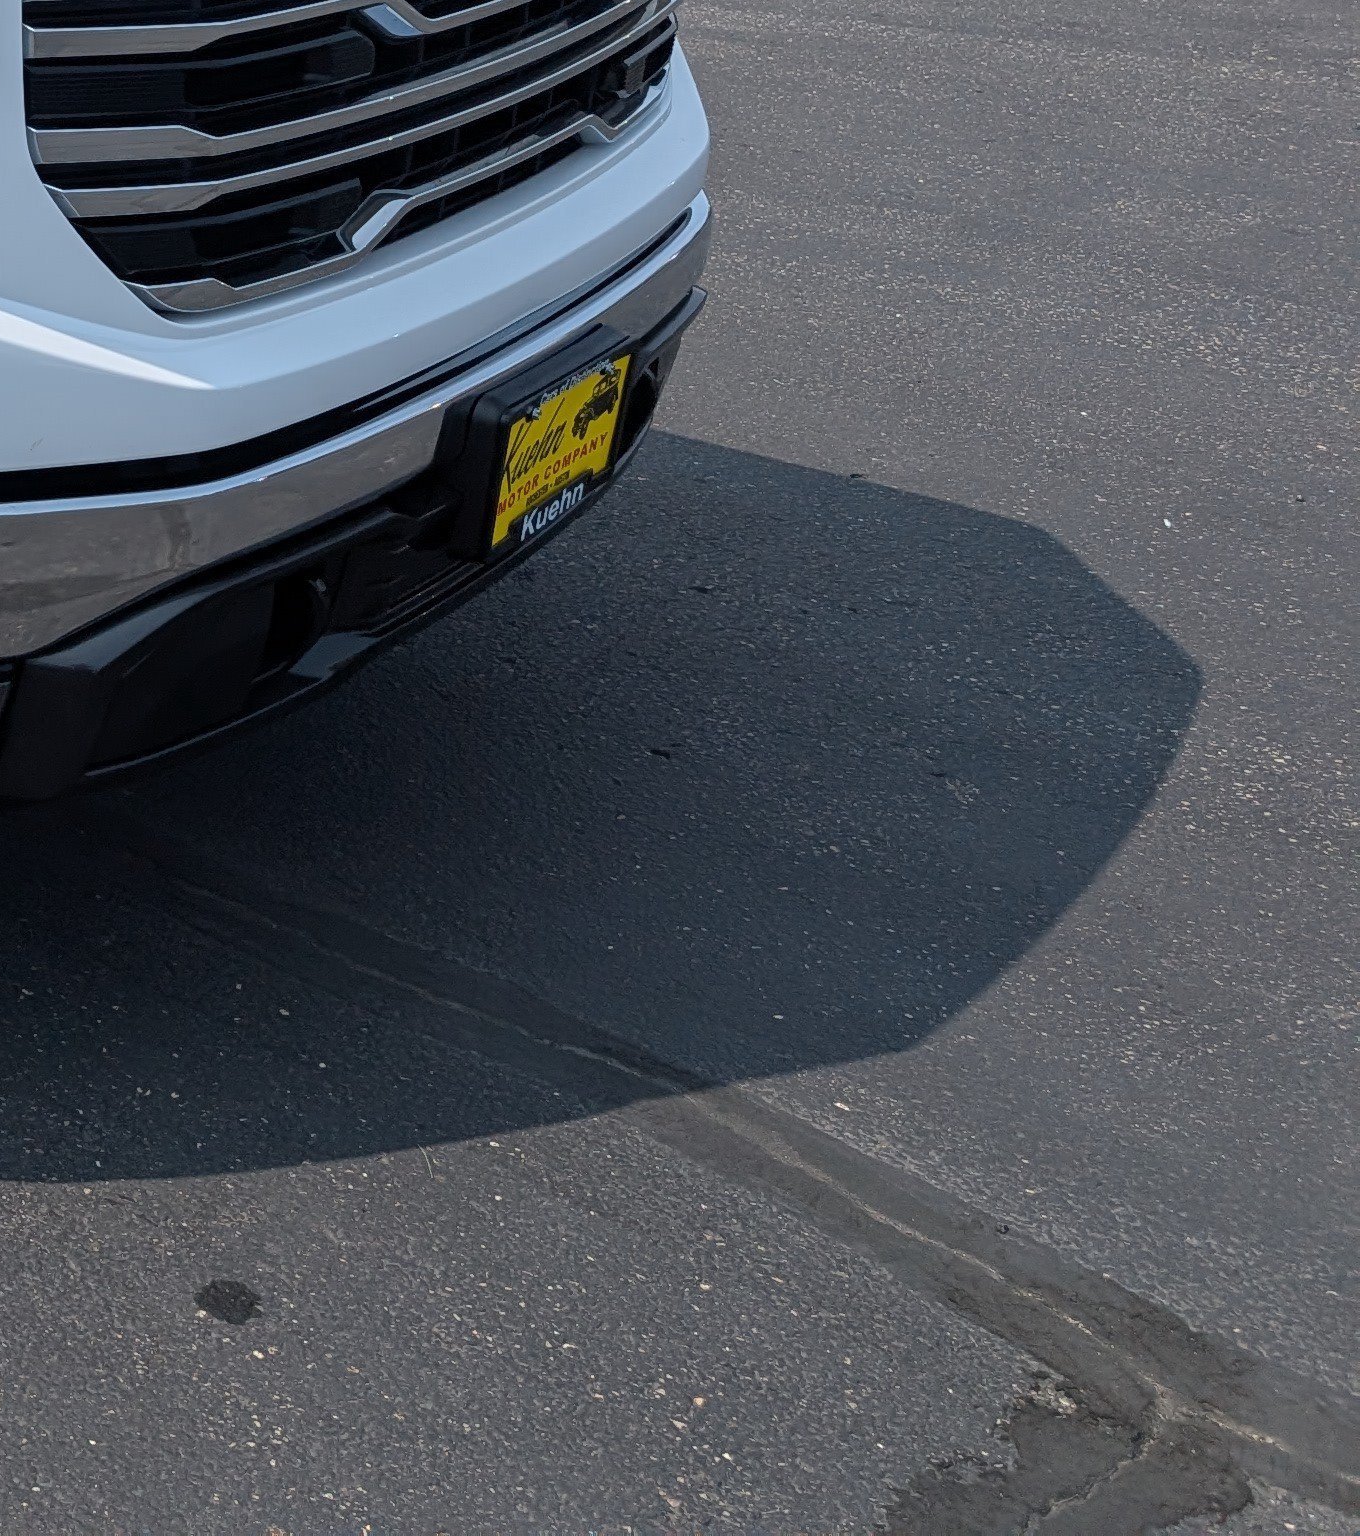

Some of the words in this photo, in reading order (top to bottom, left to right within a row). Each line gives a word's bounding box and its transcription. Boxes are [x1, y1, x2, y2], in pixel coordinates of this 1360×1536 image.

[496, 473, 540, 517] MOTOR
[543, 431, 609, 480] COMPANY
[504, 397, 567, 494] Kuehn
[520, 482, 585, 542] Kuehn
